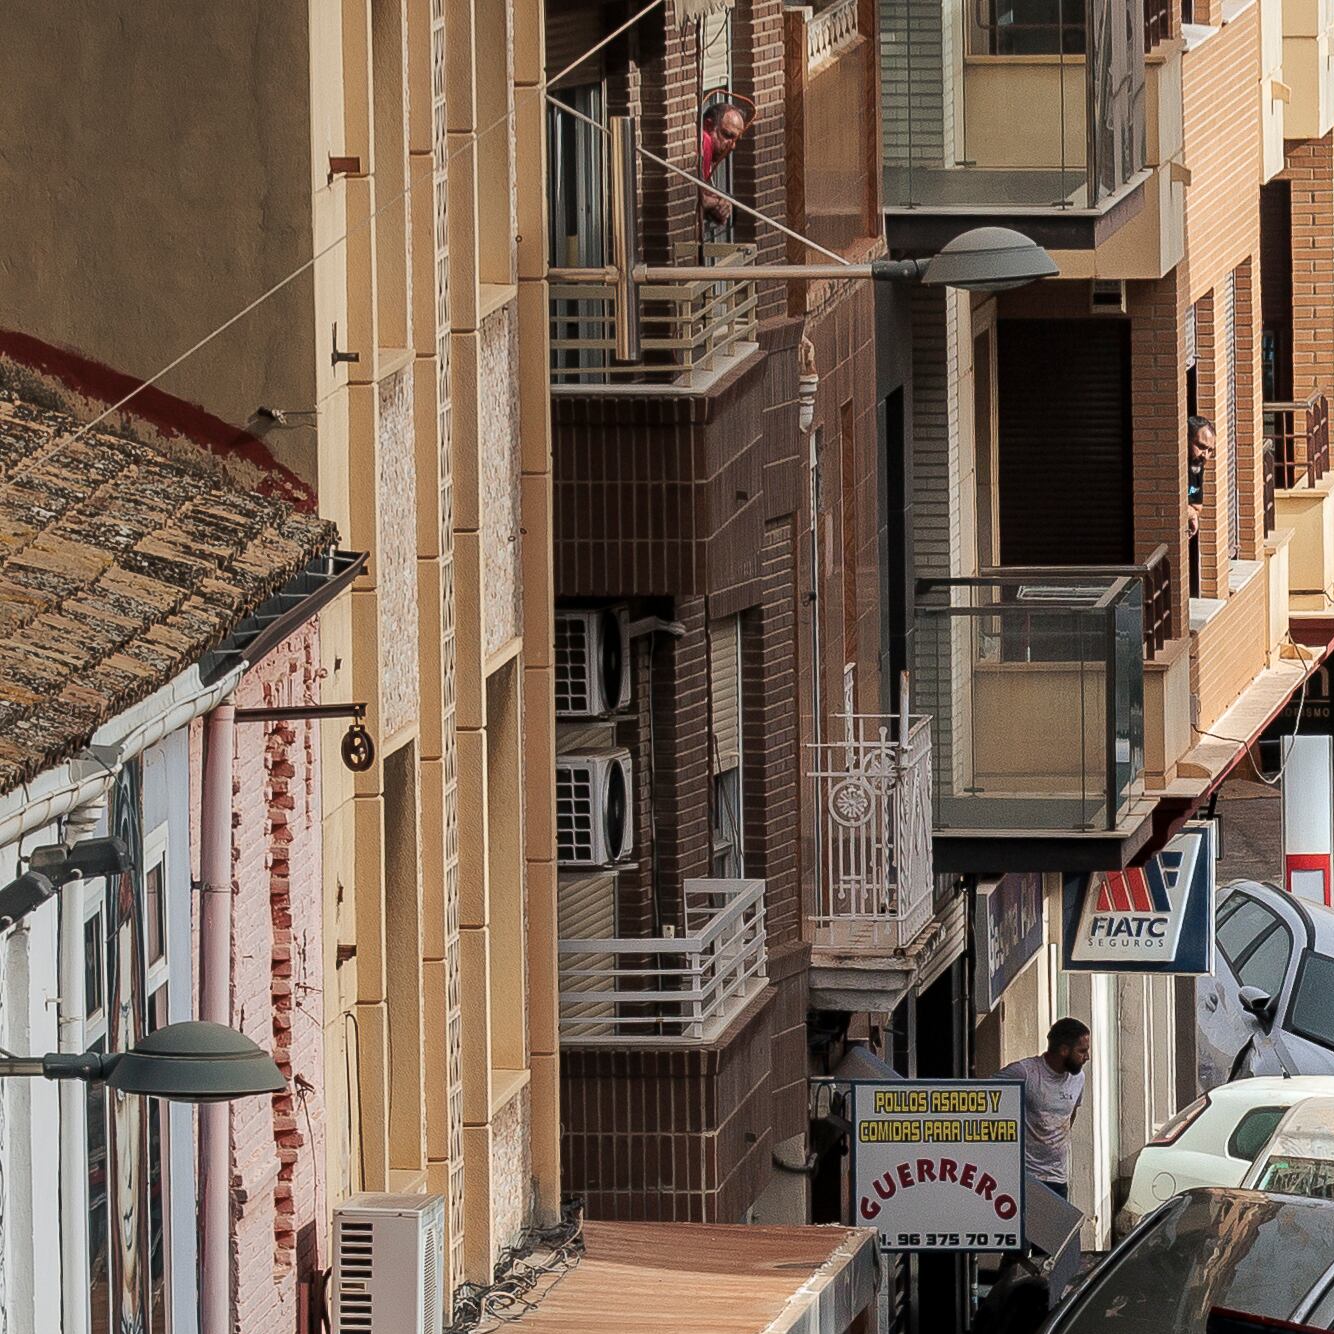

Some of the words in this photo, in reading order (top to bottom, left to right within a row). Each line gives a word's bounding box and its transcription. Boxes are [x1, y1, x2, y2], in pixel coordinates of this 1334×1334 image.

[1090, 915, 1169, 938] FIATC
[1087, 937, 1164, 948] SEGUROS
[874, 1090, 929, 1114] POLLOS
[930, 1090, 988, 1114] ASADOS
[988, 1089, 1002, 1113] Y
[859, 1119, 922, 1143] COMIDAS
[922, 1120, 962, 1143] PARA
[963, 1119, 1018, 1142] LLEVAR
[860, 1157, 1018, 1221] GUERRERO
[897, 1233, 921, 1246] 96
[926, 1233, 960, 1246] 375
[965, 1233, 988, 1246] 70
[994, 1233, 1017, 1246] 76
